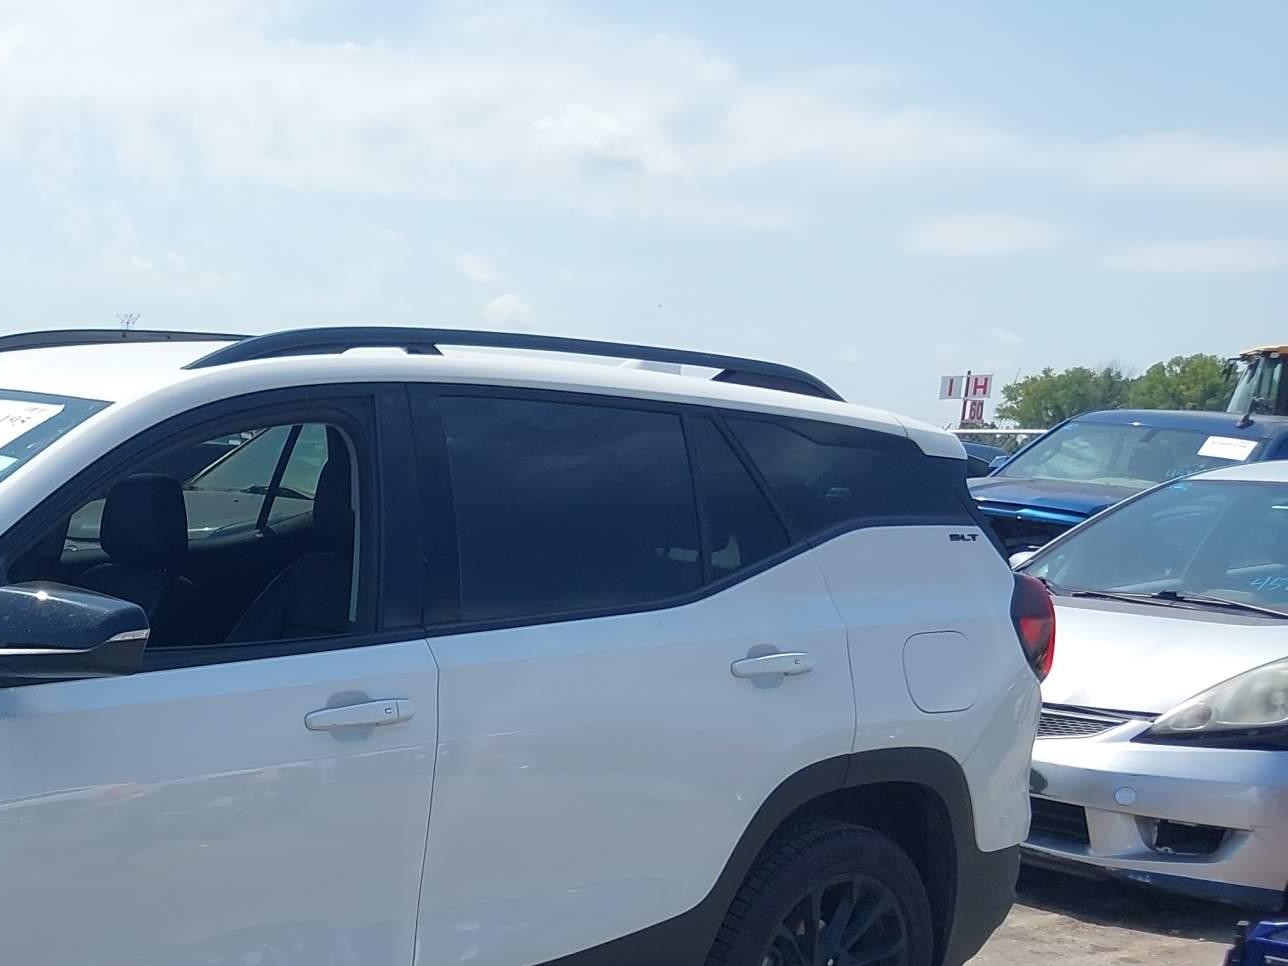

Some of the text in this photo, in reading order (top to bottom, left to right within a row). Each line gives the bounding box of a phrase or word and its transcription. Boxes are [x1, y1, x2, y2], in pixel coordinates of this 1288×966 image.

[972, 377, 988, 395] H
[969, 401, 984, 420] 60
[949, 533, 979, 541] SLT
